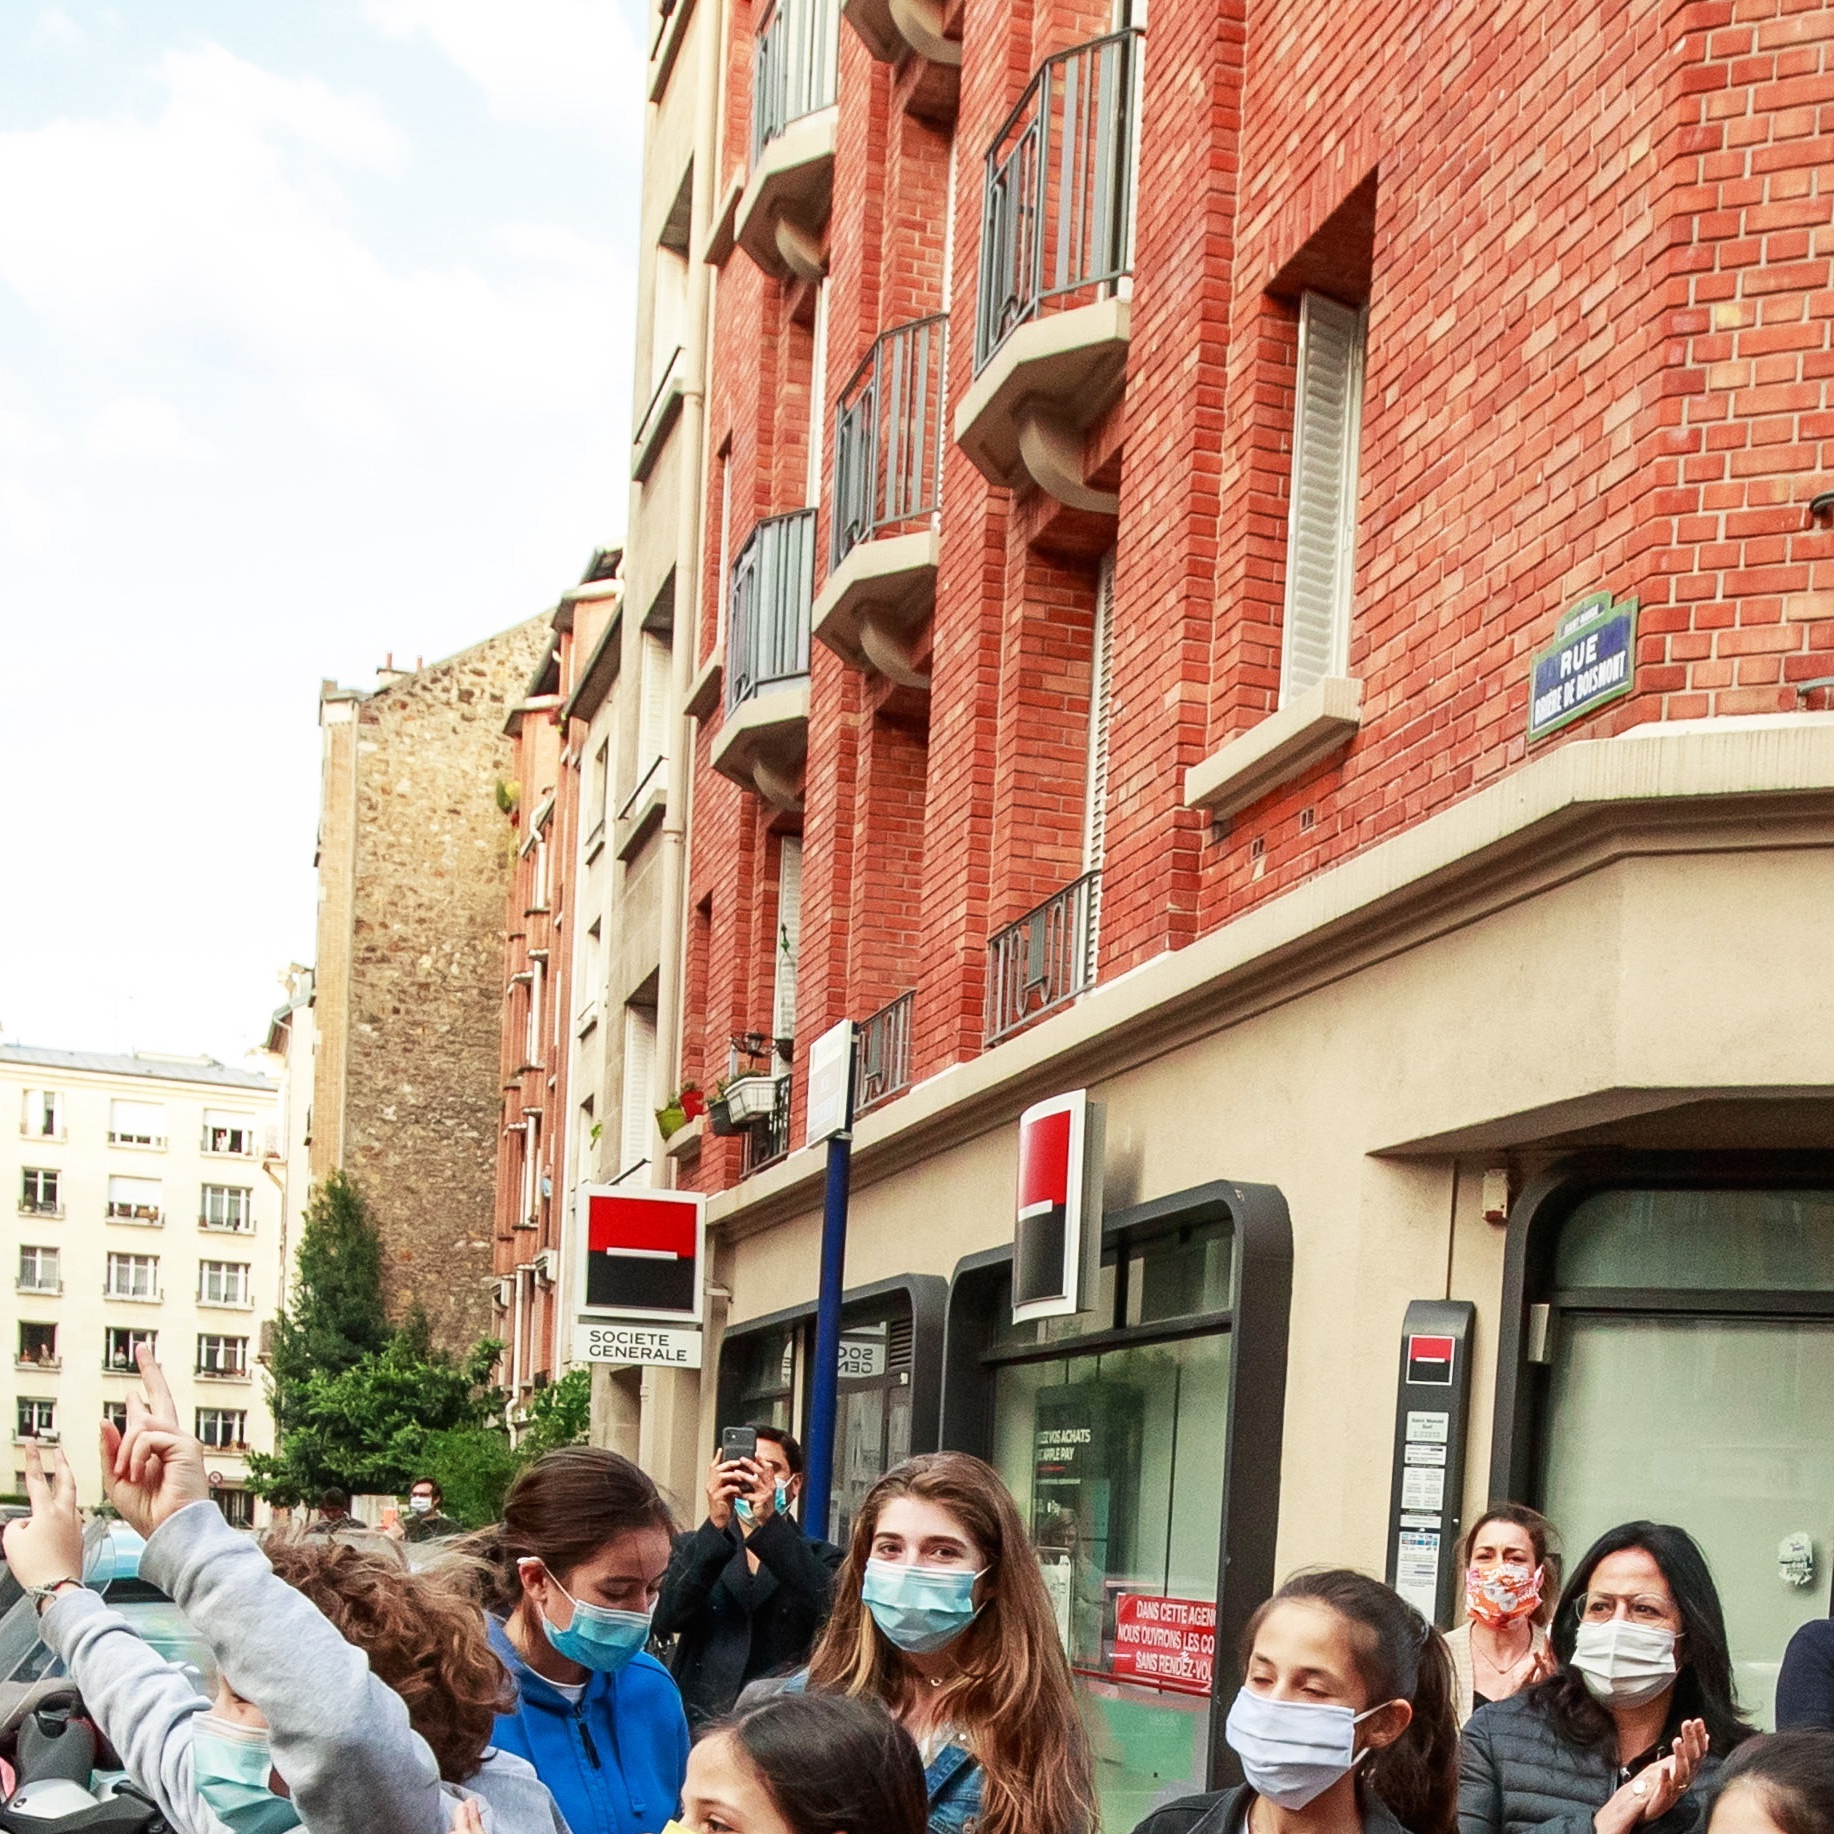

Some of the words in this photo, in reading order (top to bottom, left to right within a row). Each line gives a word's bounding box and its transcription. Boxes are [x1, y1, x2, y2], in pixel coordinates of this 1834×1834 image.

[1560, 633, 1599, 679] RUE
[1563, 679, 1576, 709] DE
[589, 1330, 670, 1346] SOCIETE
[588, 1344, 687, 1362] GENERALE
[1136, 1600, 1159, 1620] DANS
[1160, 1602, 1188, 1624] CETTE
[1117, 1624, 1140, 1643] NOUS
[1141, 1626, 1182, 1650] OUVRONS
[1183, 1632, 1199, 1653] LES
[1135, 1650, 1158, 1671] SANS
